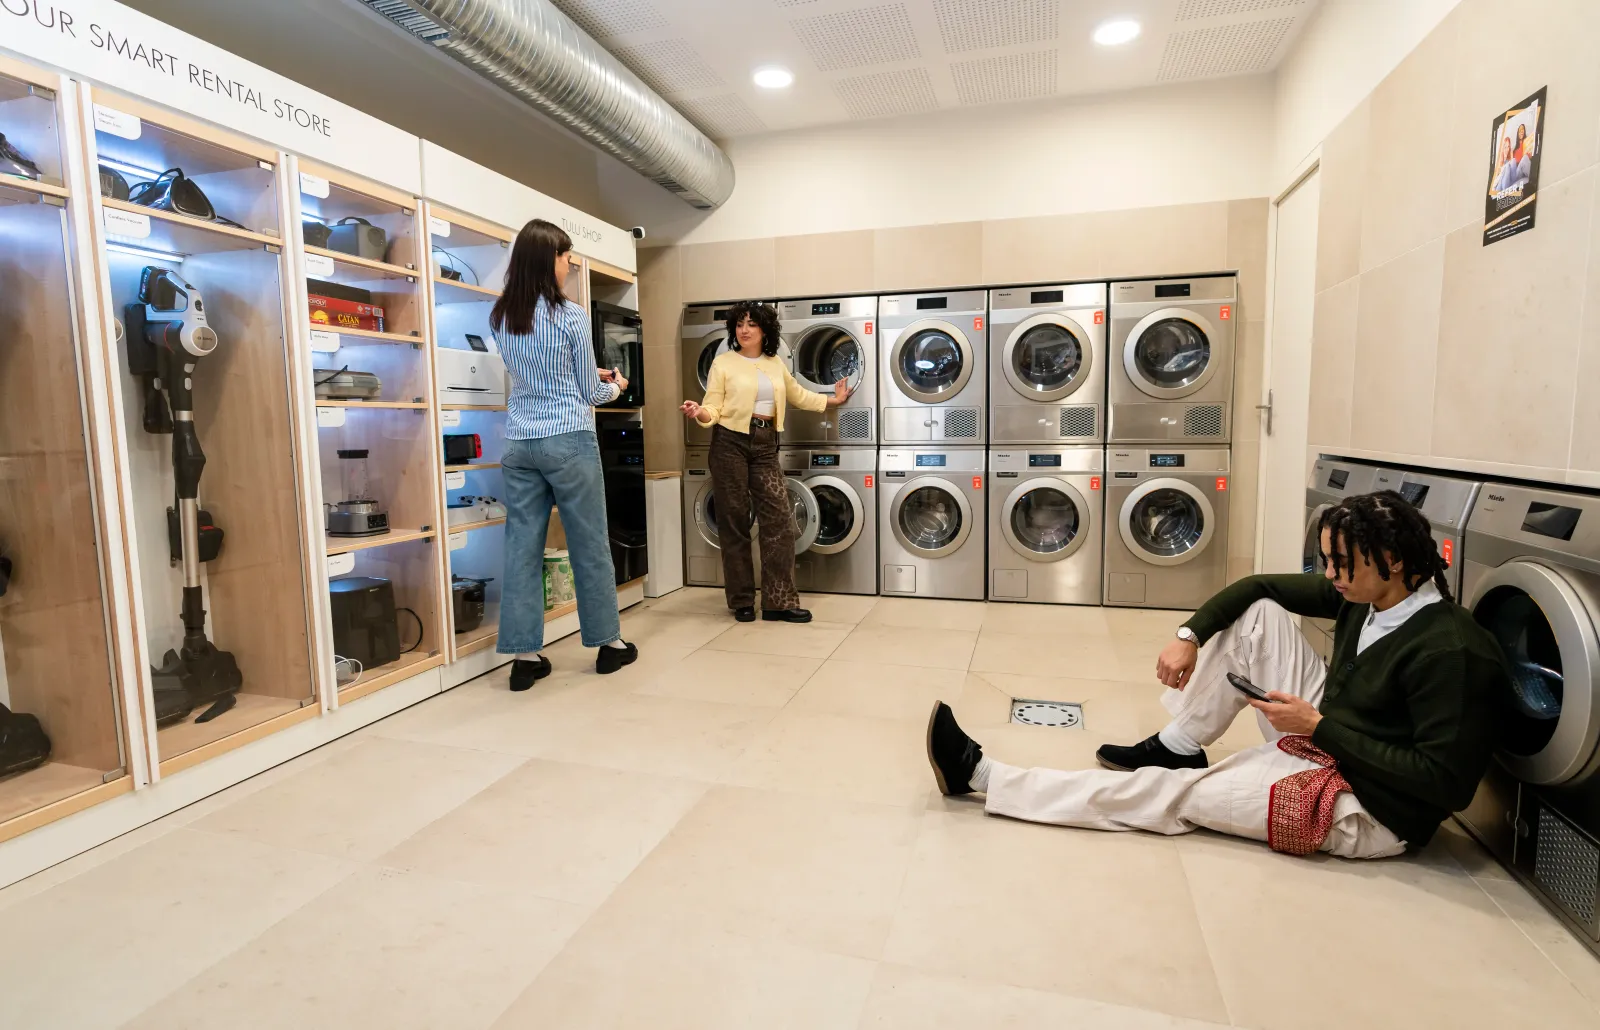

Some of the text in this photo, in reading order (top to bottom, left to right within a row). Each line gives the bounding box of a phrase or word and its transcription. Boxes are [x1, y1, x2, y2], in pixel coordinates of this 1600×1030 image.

[89, 23, 178, 76] SMART
[188, 63, 268, 113] RENTAL
[273, 98, 332, 138] STORE
[1496, 183, 1518, 201] REFER
[1495, 192, 1524, 211] FRIEND
[561, 217, 602, 243] TULU SHOP
[337, 313, 360, 325] CATAN
[1487, 494, 1505, 502] Miele
